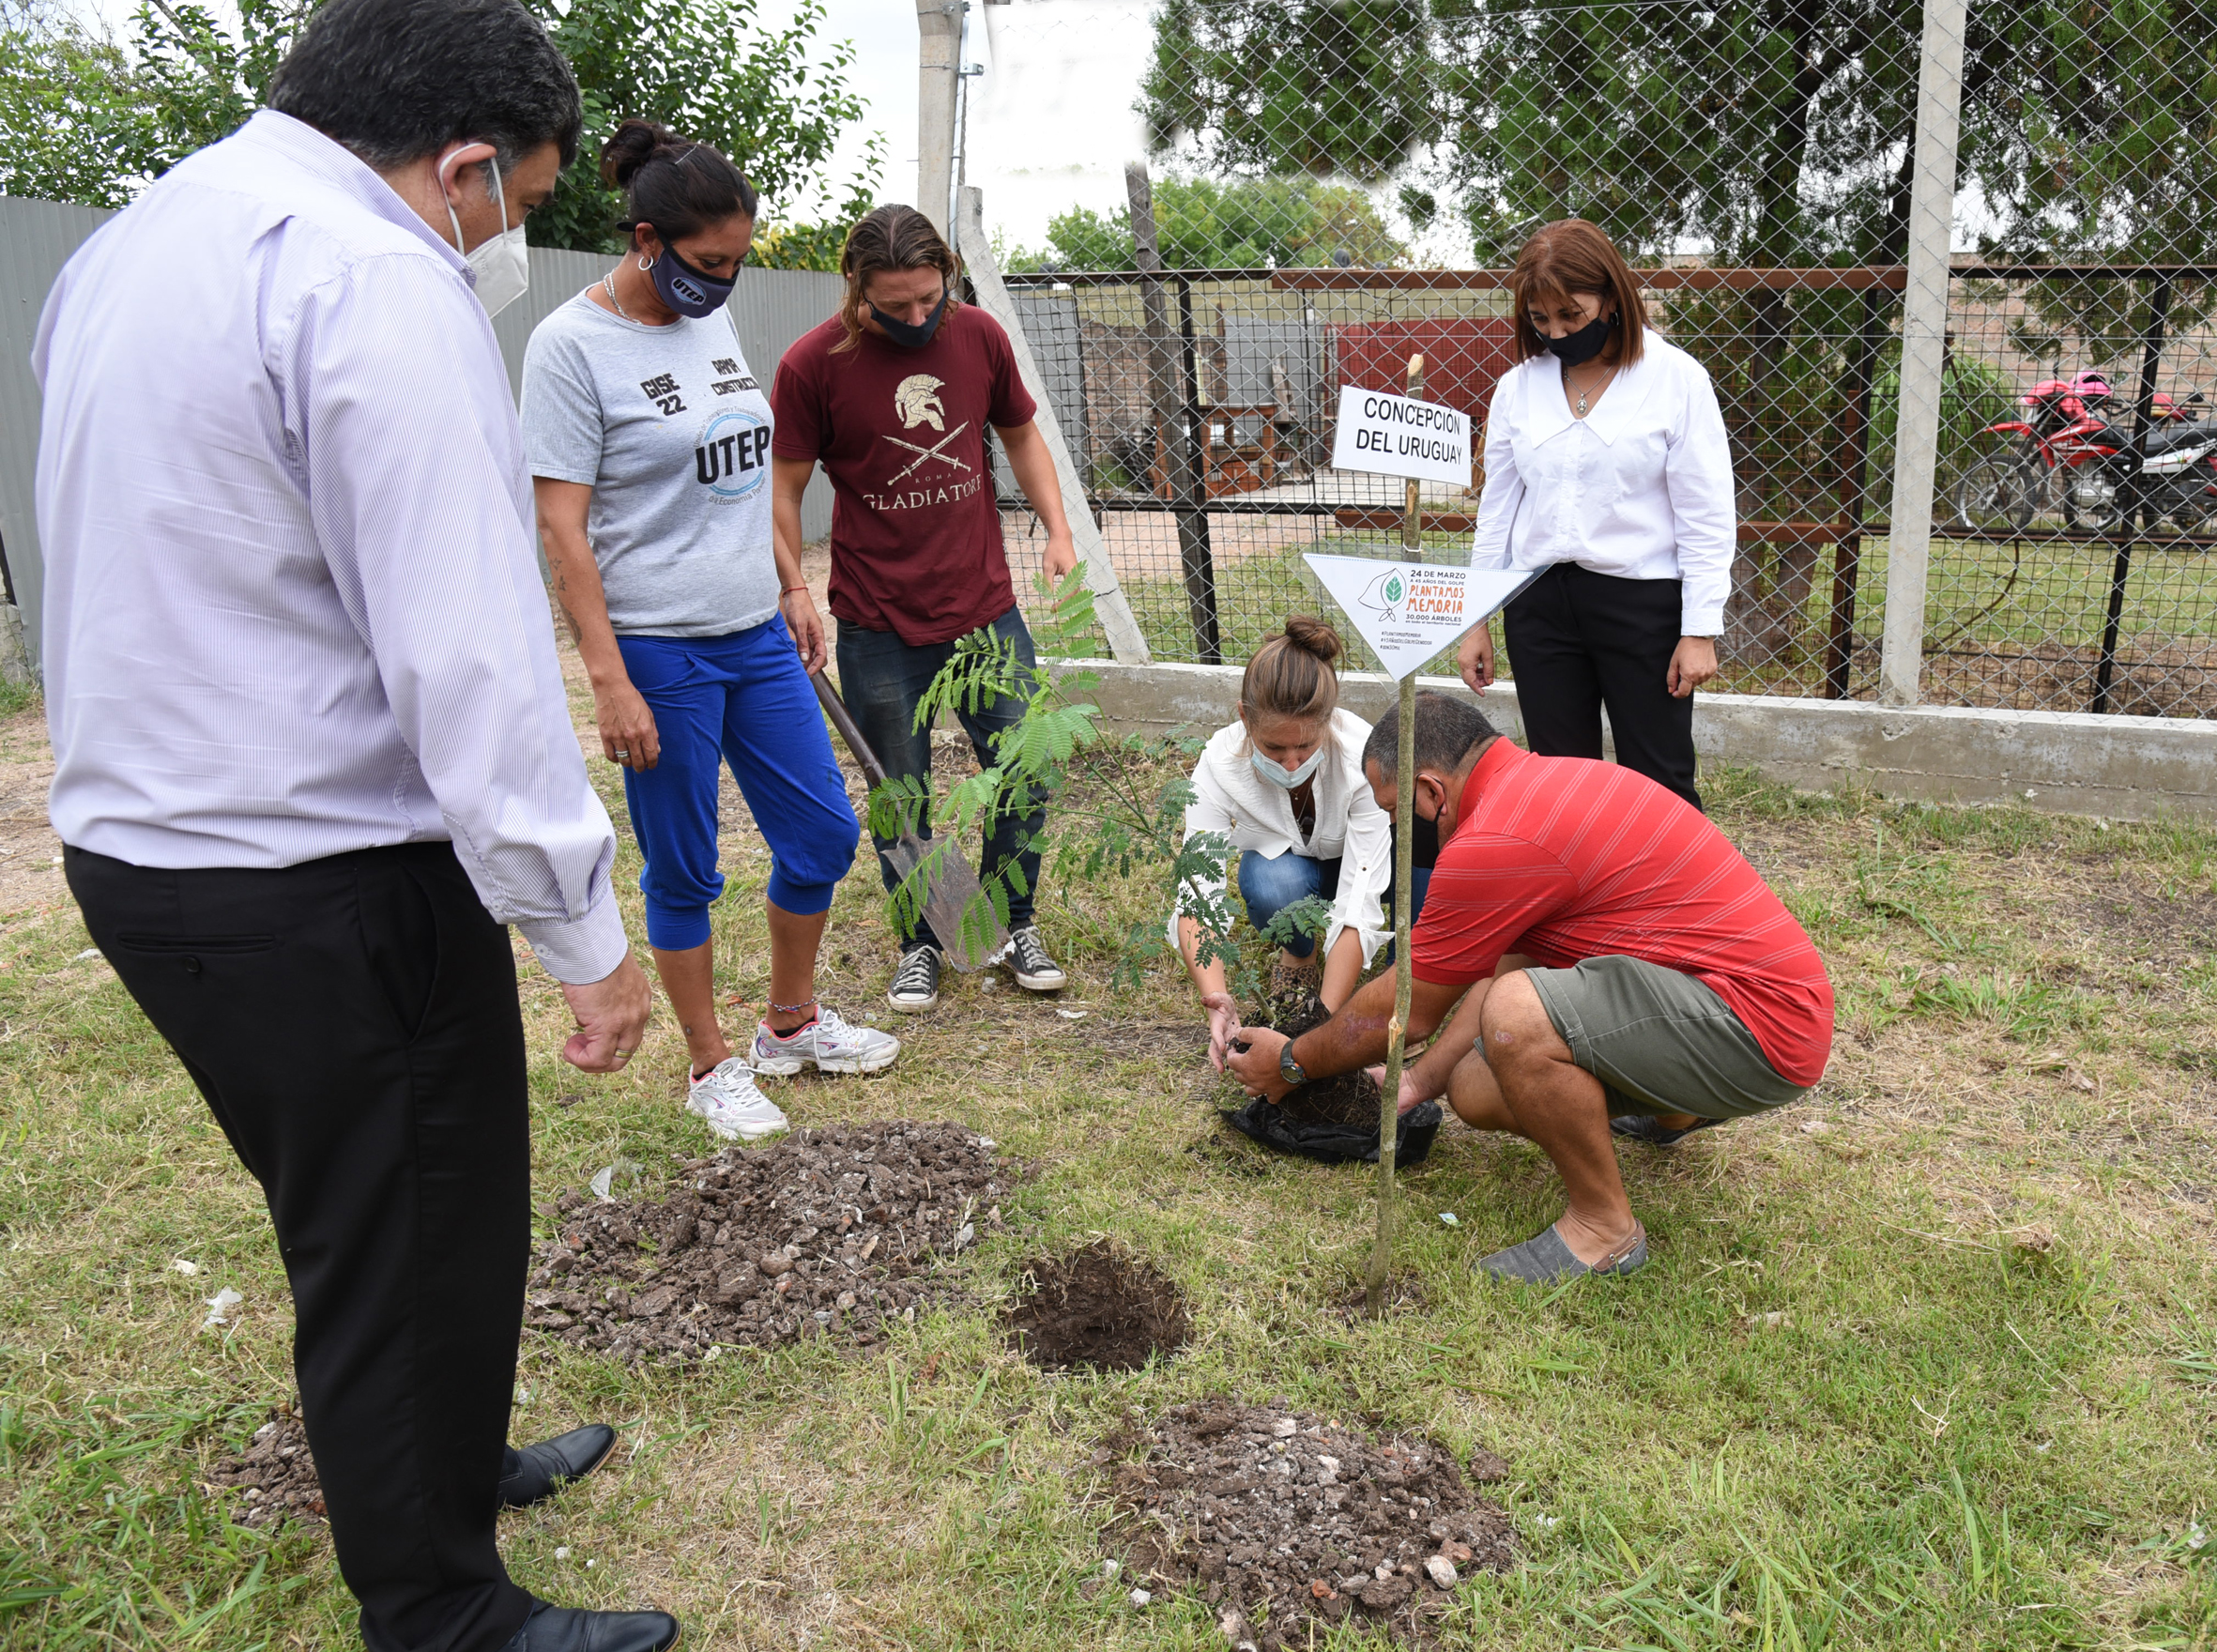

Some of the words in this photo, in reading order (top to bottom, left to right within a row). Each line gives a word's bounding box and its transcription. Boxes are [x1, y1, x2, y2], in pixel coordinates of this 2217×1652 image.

[673, 278, 704, 302] UTEP
[711, 358, 742, 376] RAMA
[640, 373, 681, 400] GISE
[655, 394, 687, 416] 22
[1364, 397, 1460, 436] CONCEPCIÓN
[696, 425, 771, 484] UTEP
[1356, 428, 1393, 453] DEL
[1399, 435, 1462, 465] URUGUAY
[915, 472, 952, 483] ROMA
[1409, 584, 1464, 599] PLANTAMOS
[1406, 597, 1463, 614] MEMORIA
[1430, 614, 1462, 622] ÁRBOLES
